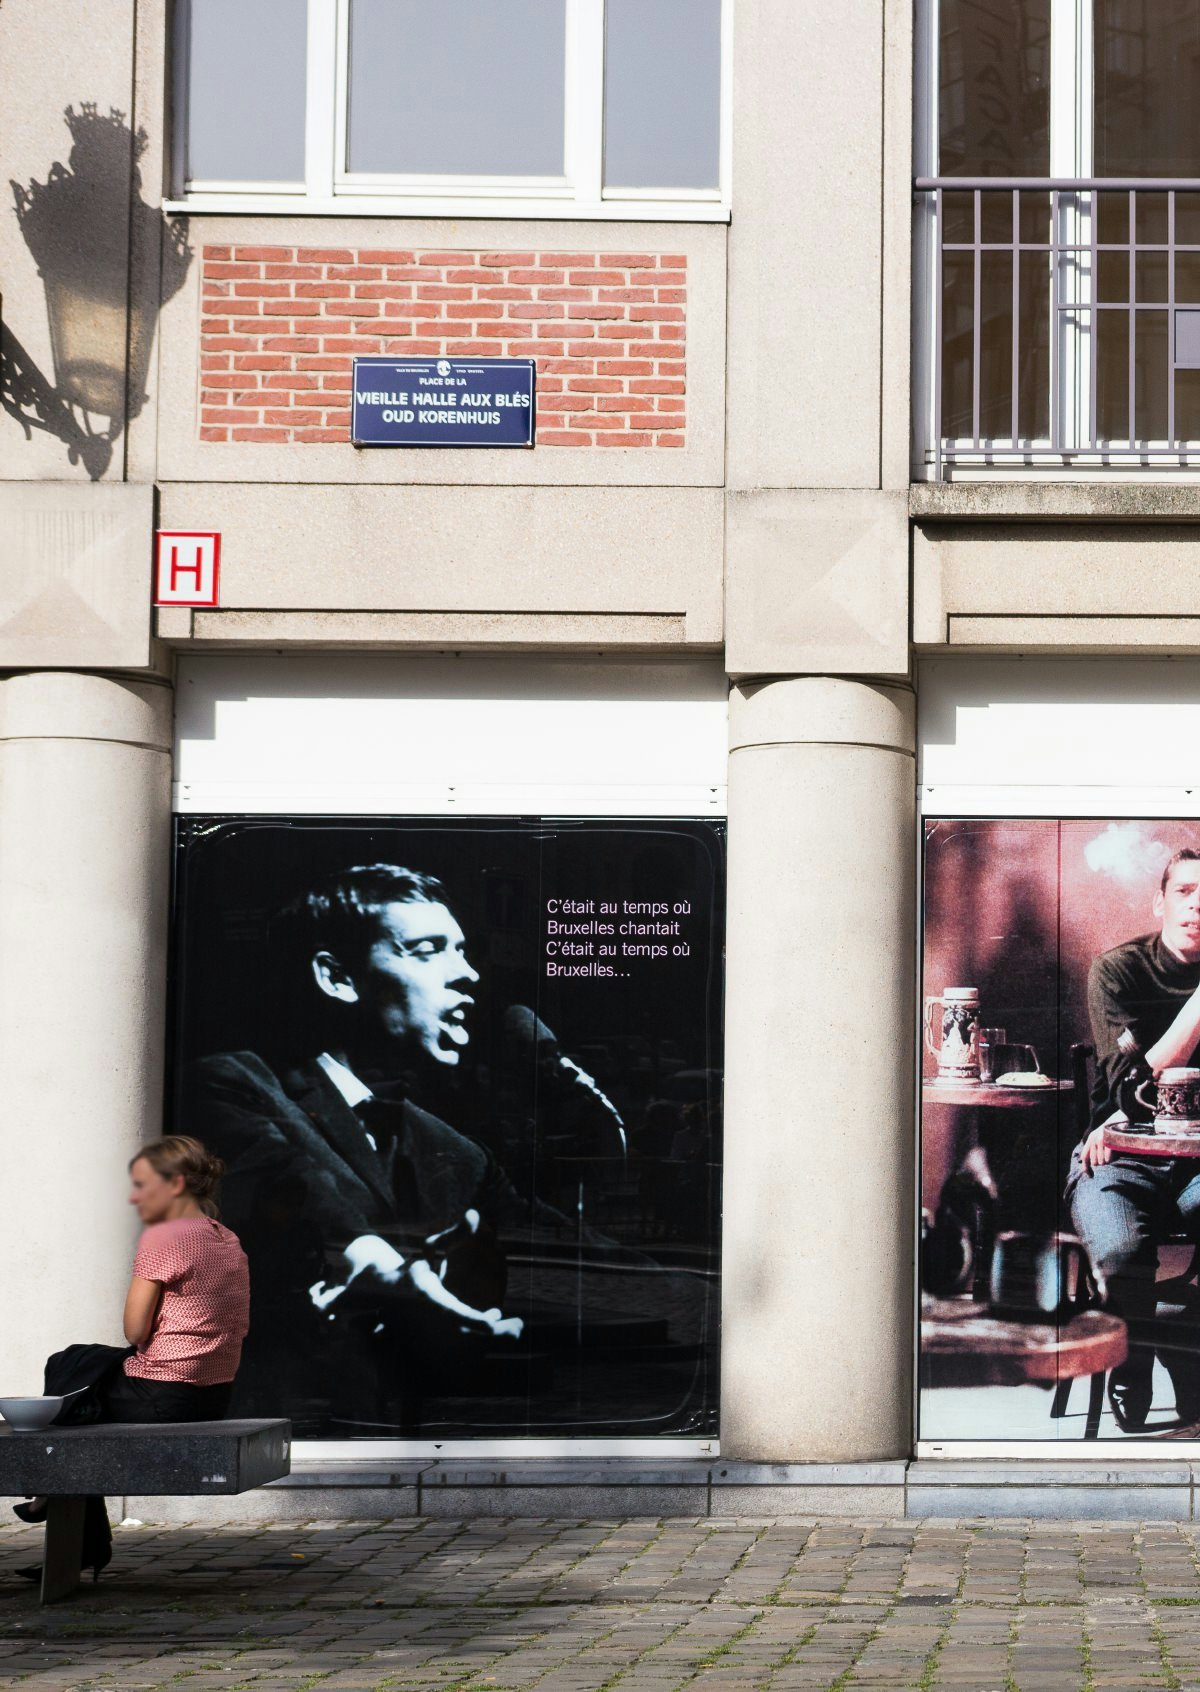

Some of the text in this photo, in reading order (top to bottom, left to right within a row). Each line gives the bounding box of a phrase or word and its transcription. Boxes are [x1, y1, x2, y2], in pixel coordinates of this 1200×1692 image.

[419, 377, 467, 386] PLACE DE LA
[356, 391, 530, 408] VIEILLE HALLE AUX BLÉS
[382, 410, 501, 425] OUD KORENHUIS
[170, 546, 203, 592] H
[546, 898, 691, 917] C’était au temps où
[547, 920, 680, 935] Bruxelles chantait
[546, 941, 690, 959] C’était au temps où
[546, 962, 631, 977] Bruxelles...
